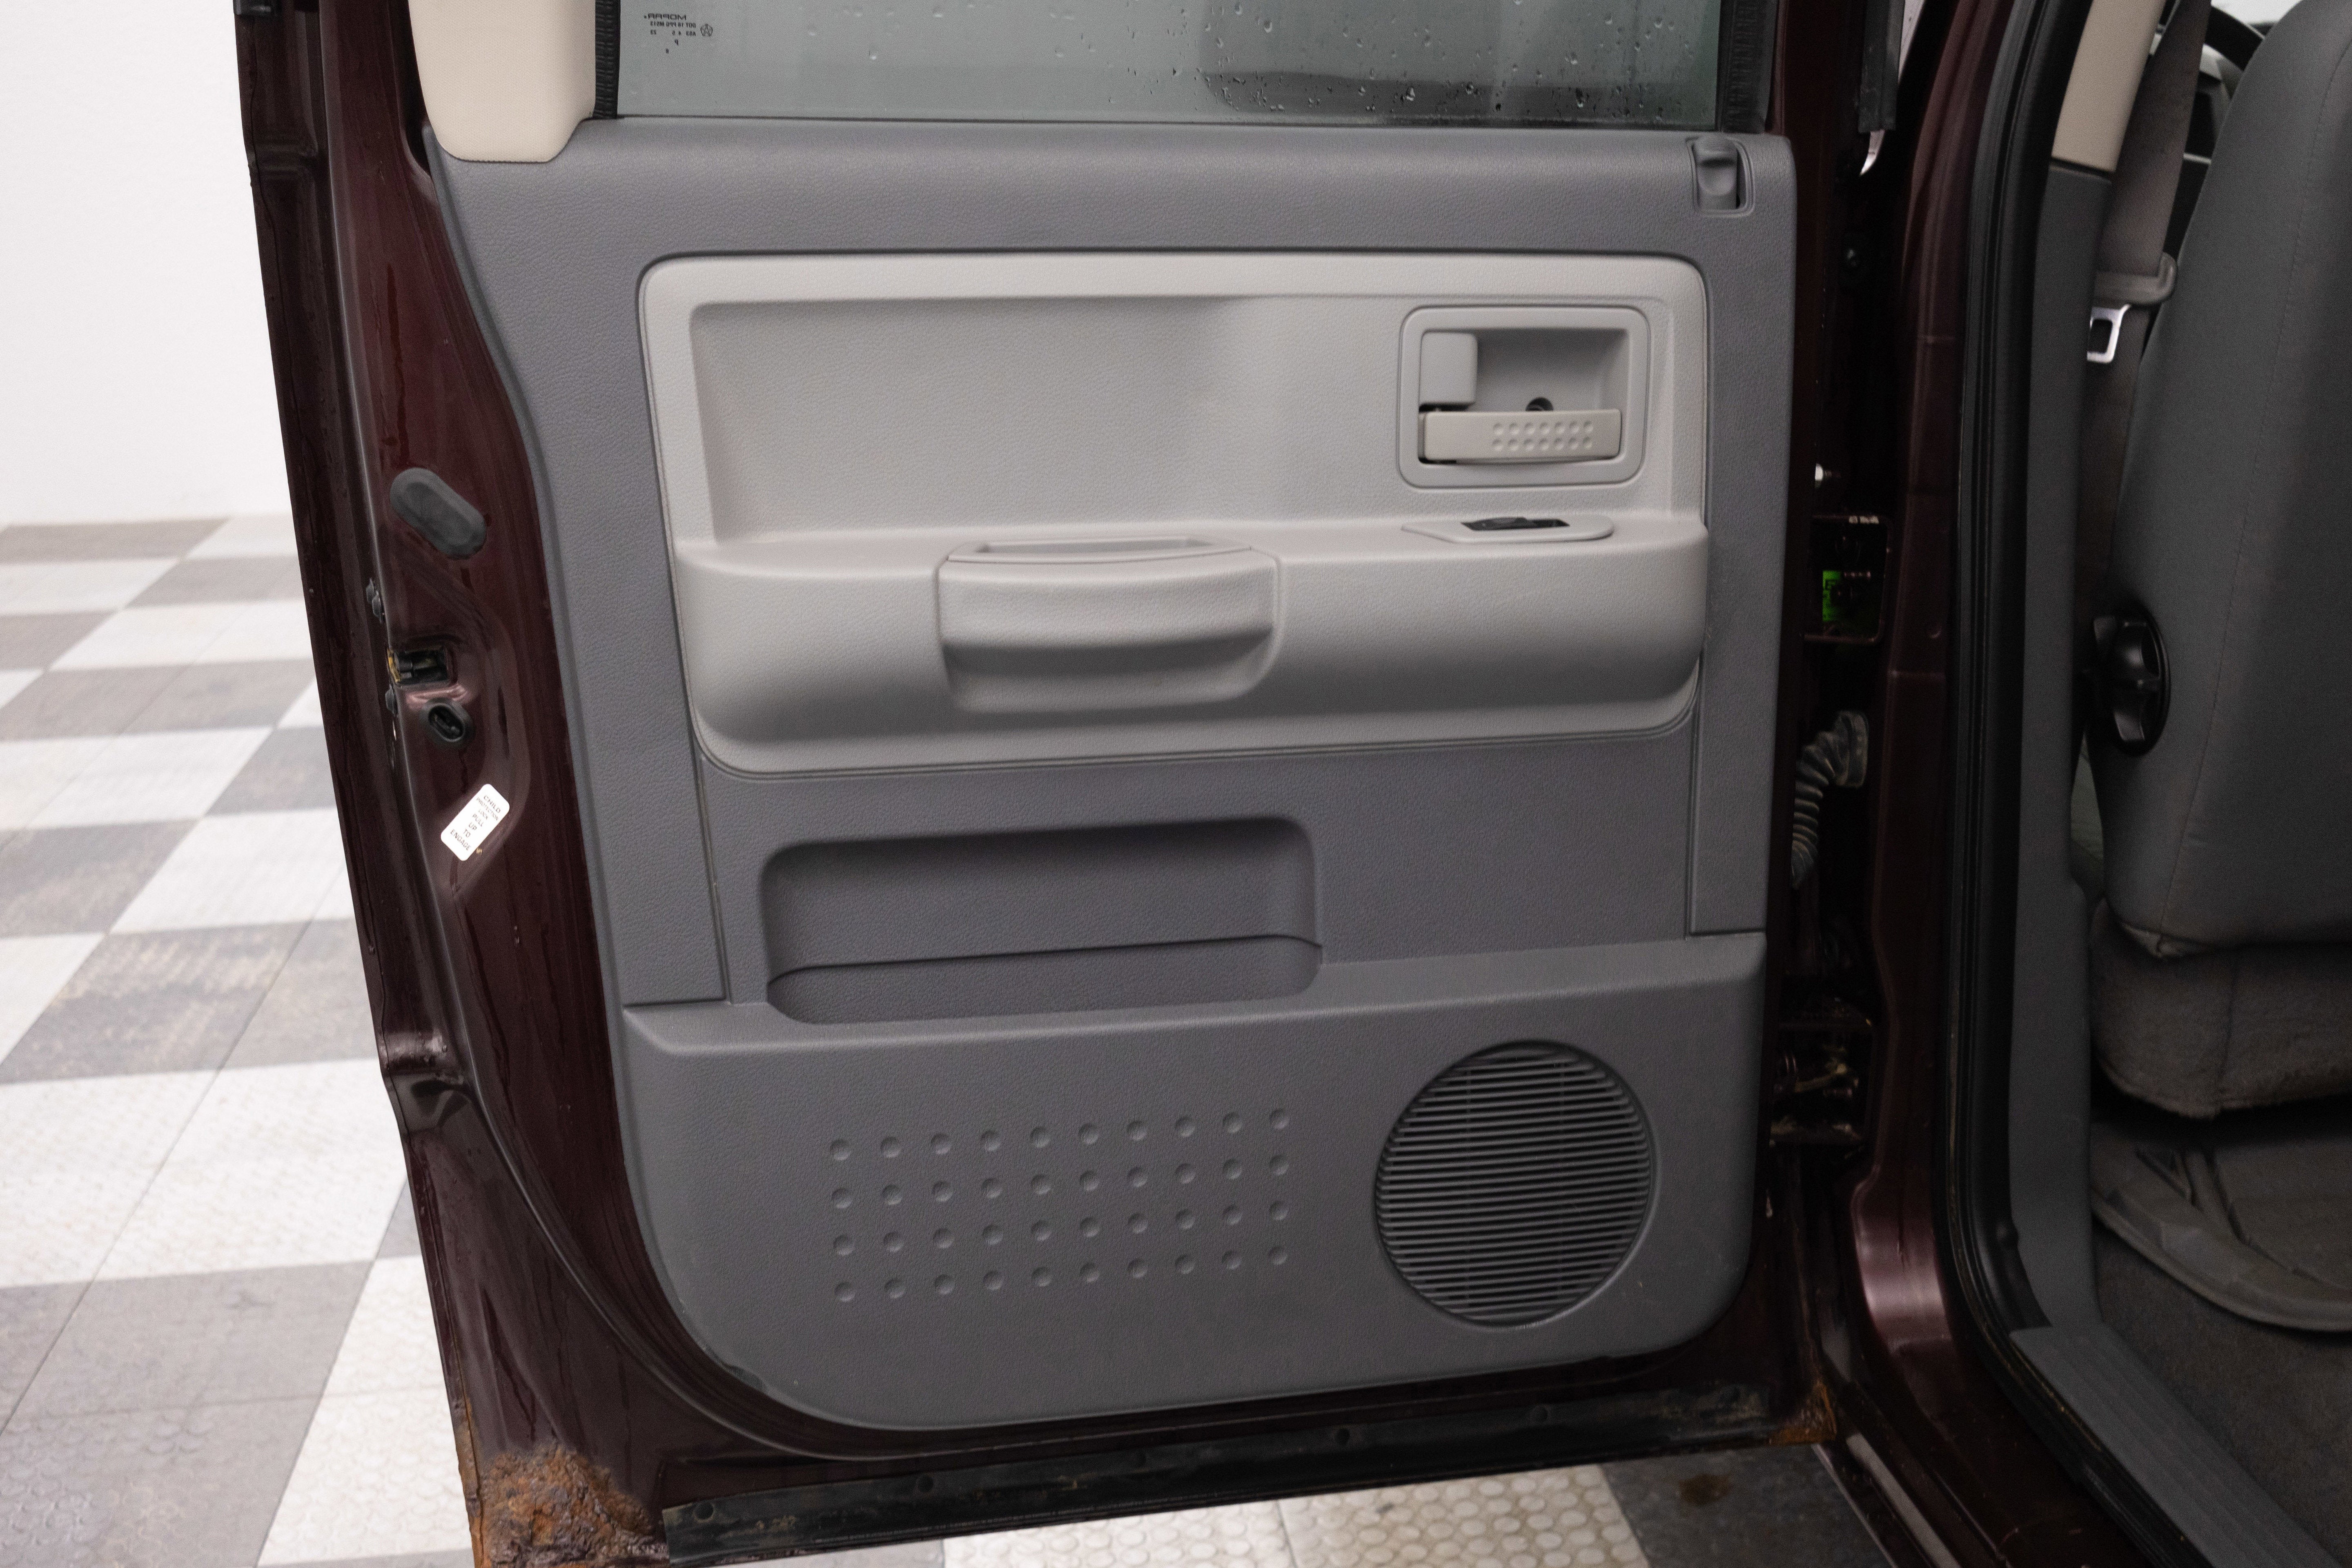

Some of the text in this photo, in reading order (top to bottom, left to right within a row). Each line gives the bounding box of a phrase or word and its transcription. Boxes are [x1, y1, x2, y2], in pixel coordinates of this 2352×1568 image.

[476, 797, 499, 821] PROTECTION
[483, 795, 501, 813] CHILD
[472, 813, 484, 827] PULL
[478, 809, 488, 820] LOCK
[463, 829, 471, 837] TO
[468, 822, 477, 831] UP
[450, 829, 471, 851] ENGAGE
